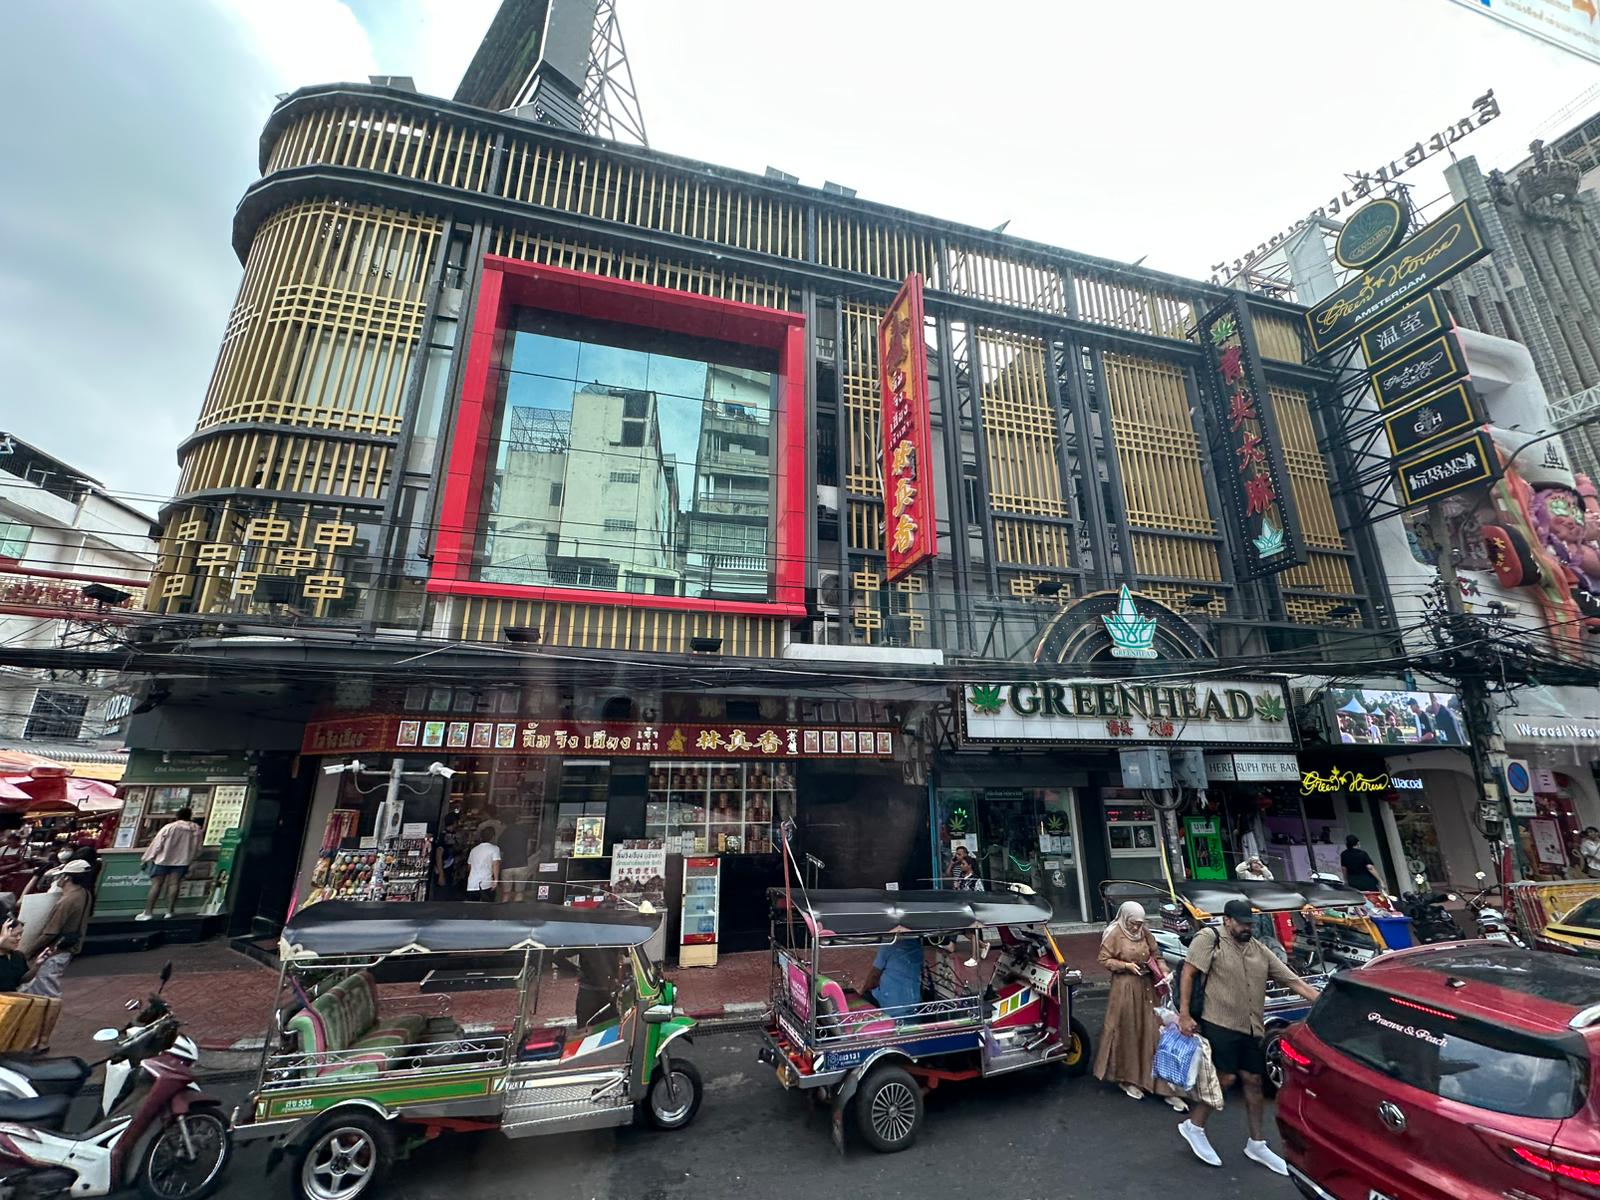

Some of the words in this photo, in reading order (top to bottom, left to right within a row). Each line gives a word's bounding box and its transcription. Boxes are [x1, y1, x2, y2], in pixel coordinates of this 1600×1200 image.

[1380, 223, 1462, 288] House
[1354, 272, 1427, 323] AMSTERDAM
[1415, 454, 1468, 479] STRAIN
[1416, 465, 1469, 489] HUNTERS
[1112, 648, 1157, 658] GREENHEAD
[1007, 681, 1255, 722] GREENHEAD
[695, 729, 783, 754] 林真香
[1236, 762, 1259, 773] BUPH
[1261, 763, 1278, 773] PHE
[1280, 763, 1299, 773] BAR
[1299, 770, 1340, 797] Green
[1343, 770, 1389, 793] House
[1391, 777, 1424, 789] Wacoal
[1404, 1026, 1415, 1036] &
